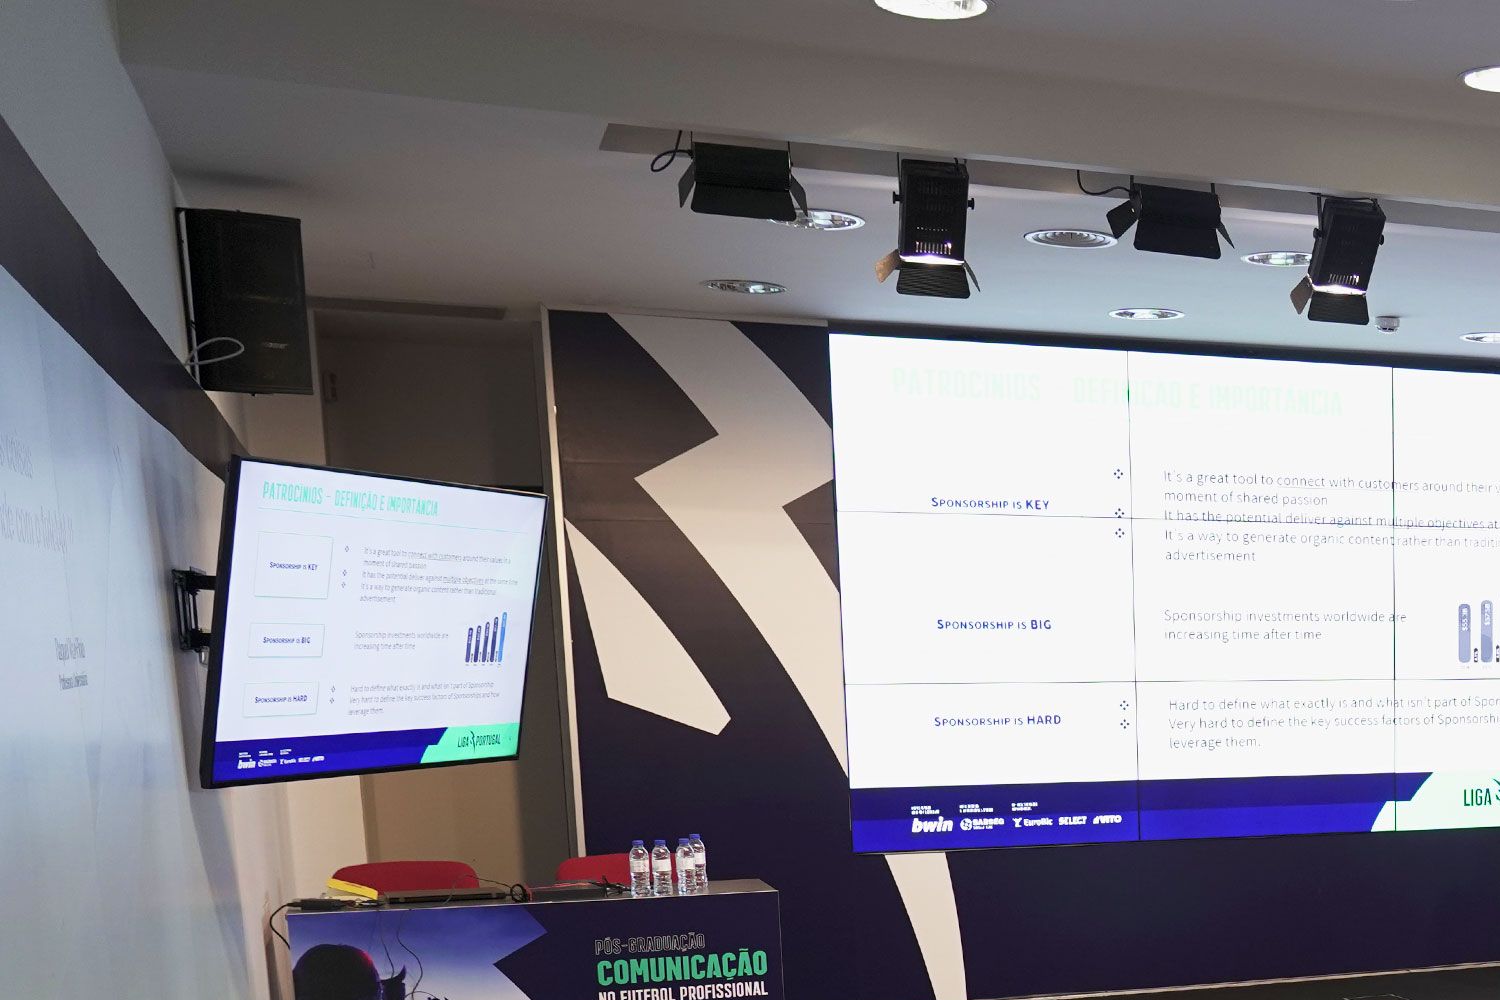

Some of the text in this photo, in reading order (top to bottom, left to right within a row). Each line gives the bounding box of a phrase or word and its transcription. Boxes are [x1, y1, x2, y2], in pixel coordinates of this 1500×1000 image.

[1186, 474, 1193, 483] a
[1197, 473, 1230, 487] great
[1233, 473, 1258, 485] tool
[1261, 475, 1274, 486] to
[1277, 476, 1326, 488] connect
[1329, 477, 1355, 489] with
[1358, 478, 1420, 491] customers
[1422, 480, 1463, 494] around
[1466, 481, 1491, 494] their
[931, 496, 1050, 511] SPONSORSHIP IS KEY
[1164, 490, 1328, 507] moment of shared passion
[1164, 509, 1174, 521] It
[1177, 510, 1199, 521] has
[1202, 510, 1221, 522] the
[1226, 511, 1281, 526] potential
[1285, 512, 1326, 524] deliver
[1329, 514, 1372, 529] against
[1376, 515, 1424, 530] multiple
[1427, 517, 1485, 531] objectives
[1487, 519, 1498, 529] at
[1187, 532, 1194, 542] a
[1198, 532, 1222, 545] way
[1226, 530, 1239, 542] to
[1242, 531, 1297, 546] generate
[1300, 531, 1344, 547] organic
[1348, 533, 1395, 546] content
[1397, 536, 1431, 547] rather
[1435, 536, 1460, 548] than
[1165, 549, 1256, 562] advertisement
[937, 618, 1052, 631] SPONSORSHIP IS BIG
[1164, 609, 1407, 624] Sponsorship investments worldwide are
[1164, 628, 1322, 644] increasing time after time
[1169, 699, 1199, 711] Hard
[1202, 700, 1215, 711] to
[1219, 698, 1257, 711] define
[1260, 698, 1290, 710] what
[1293, 698, 1336, 712] exactly
[1339, 697, 1348, 708] is
[1351, 697, 1373, 708] and
[1375, 696, 1403, 708] what
[1434, 696, 1457, 710] part
[1460, 695, 1471, 707] of
[934, 714, 1062, 728] SPONSORSHIP IS HARD
[1168, 718, 1196, 733] Very
[1199, 717, 1228, 729] hard
[1231, 717, 1244, 729] to
[1247, 717, 1285, 729] define
[1288, 716, 1308, 728] the
[1311, 716, 1331, 731] key
[1334, 715, 1379, 727] success
[1382, 714, 1421, 727] factors
[1424, 713, 1435, 726] of
[457, 733, 502, 749] LIGA PORTUGAL
[1169, 737, 1261, 752] leverage them.
[1463, 788, 1492, 807] LIGA
[911, 816, 954, 833] bwin
[594, 932, 707, 956] PÓS-GRADUAÇÃO
[596, 948, 769, 987] COMUNICAÇÃO
